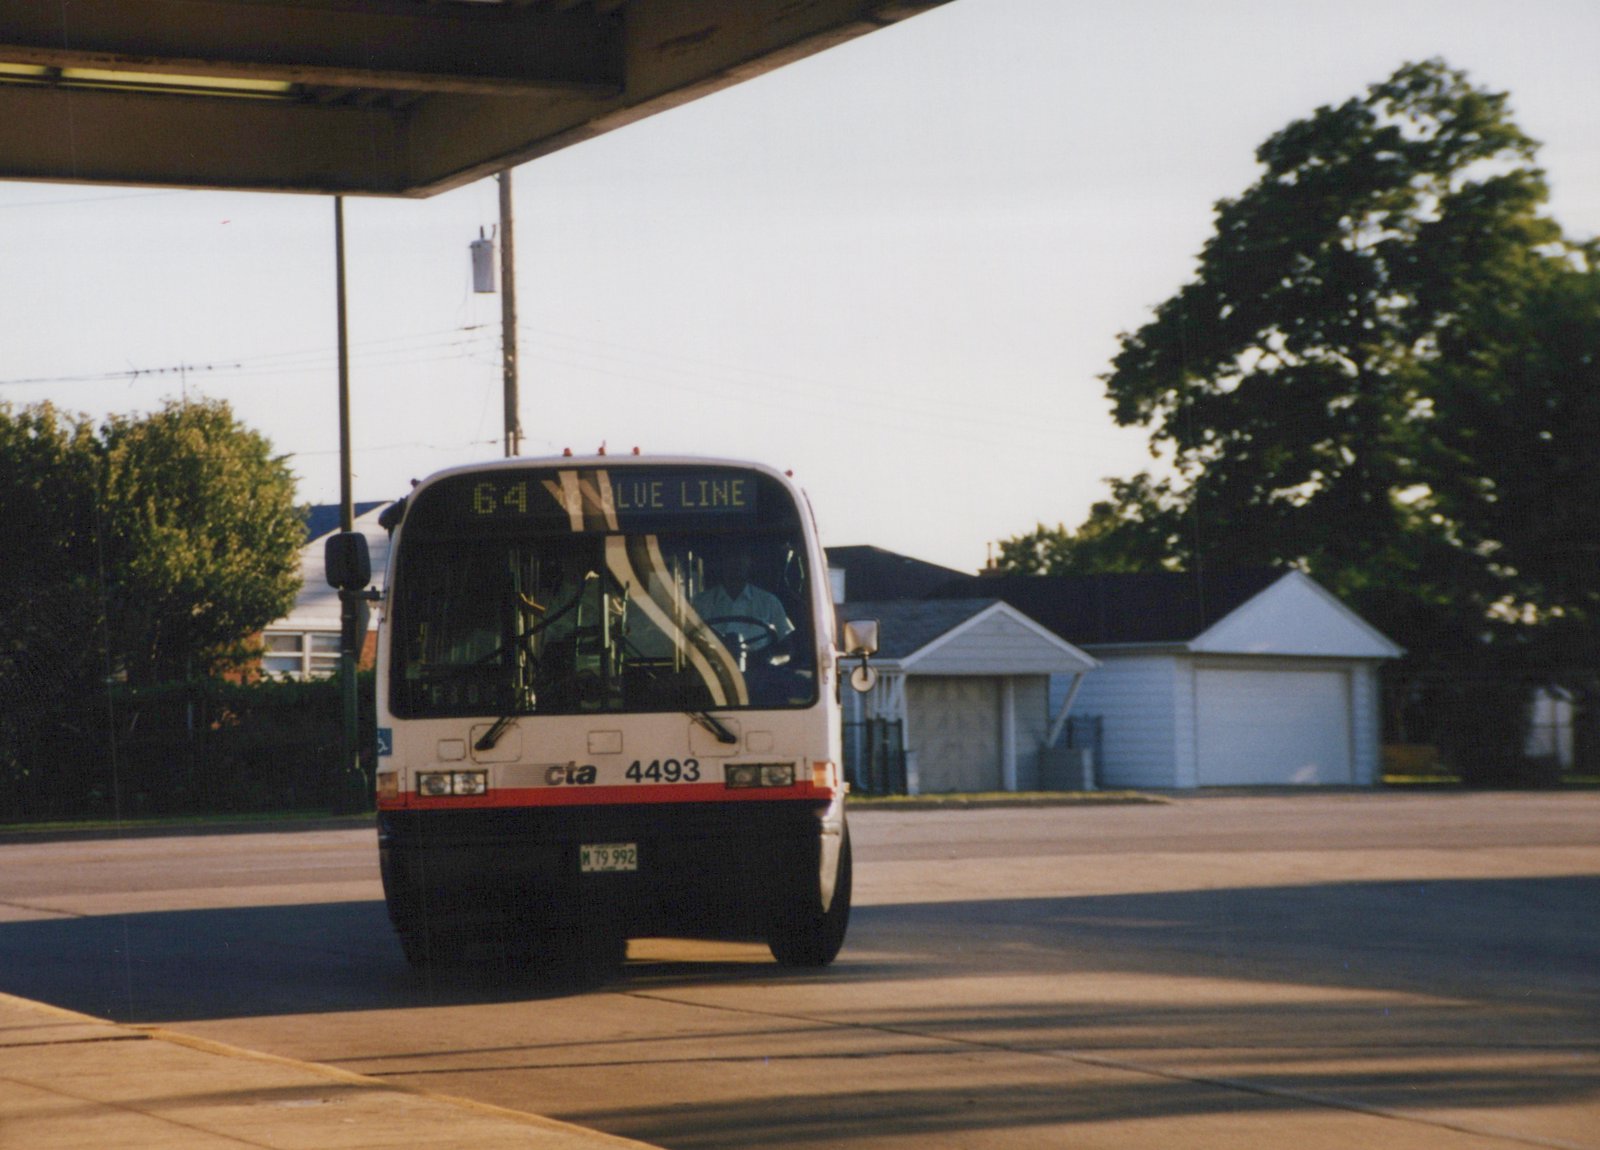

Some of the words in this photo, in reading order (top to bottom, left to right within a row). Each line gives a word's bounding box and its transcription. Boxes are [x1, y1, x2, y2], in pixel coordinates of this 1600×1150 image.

[473, 481, 527, 514] 64
[602, 481, 663, 508] LUE
[681, 480, 745, 507] LINE
[545, 761, 598, 786] cta
[625, 758, 701, 783] 4493
[594, 850, 609, 865] 79
[612, 848, 635, 865] 992
